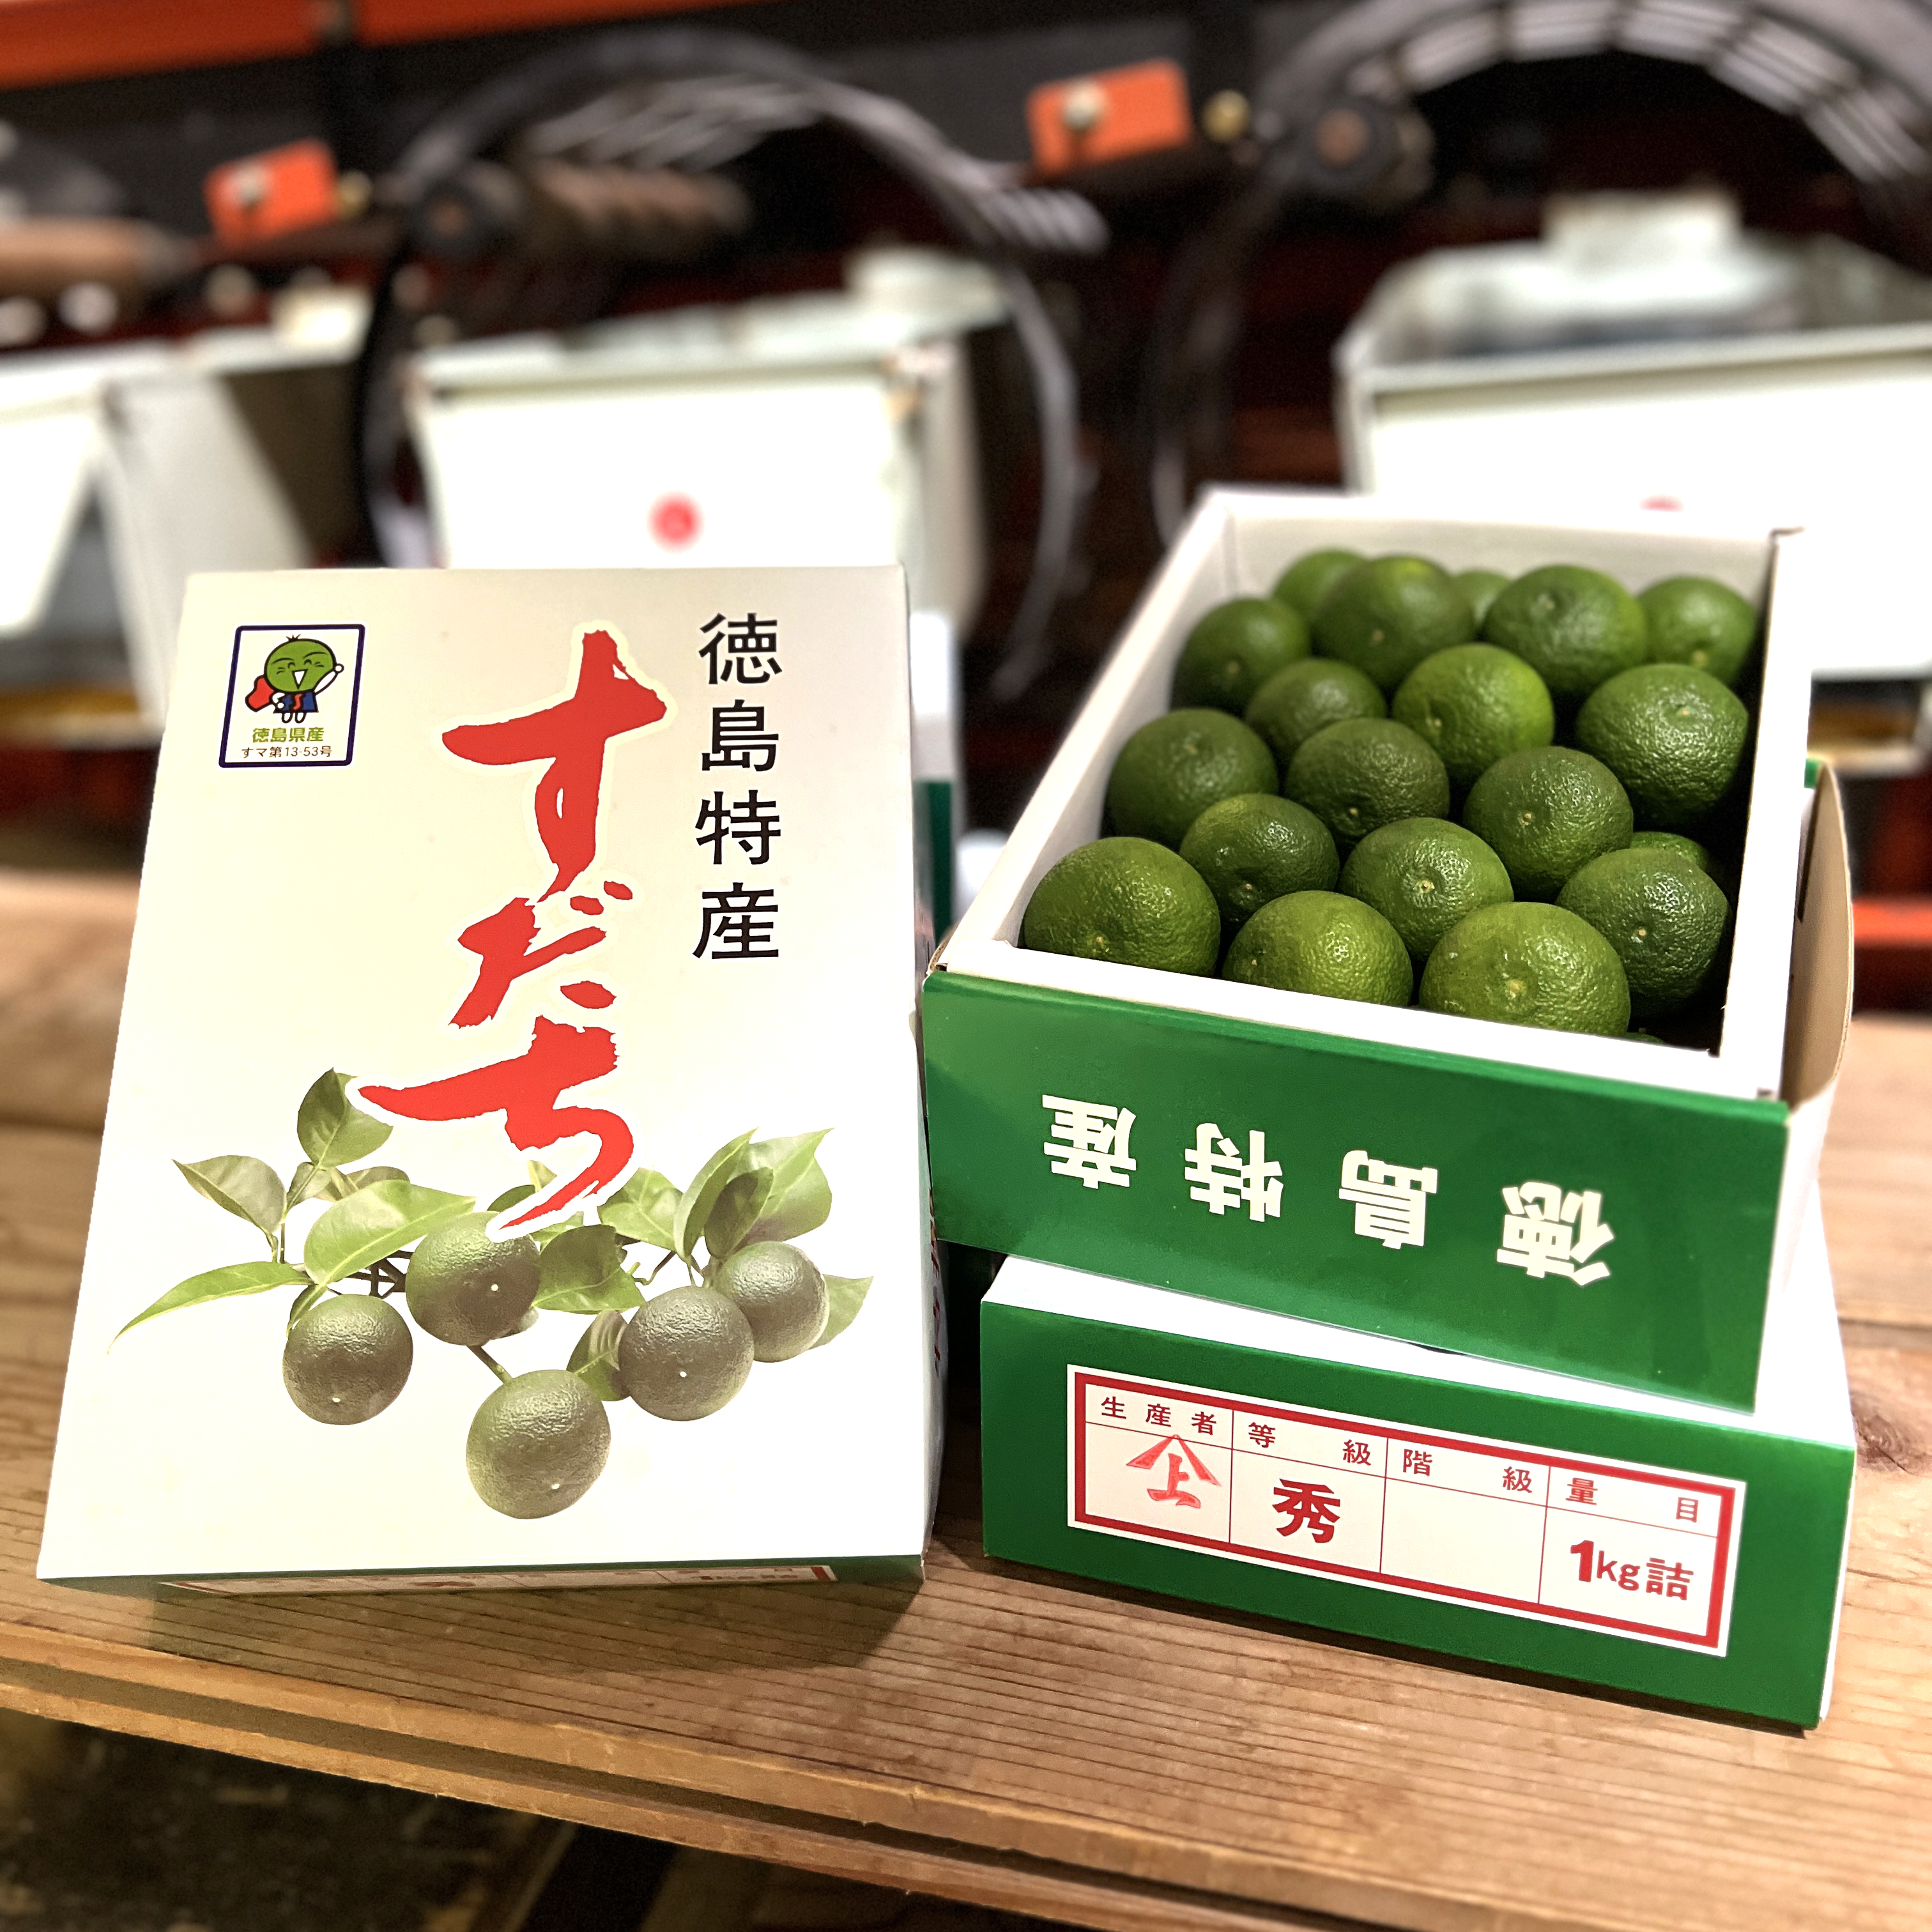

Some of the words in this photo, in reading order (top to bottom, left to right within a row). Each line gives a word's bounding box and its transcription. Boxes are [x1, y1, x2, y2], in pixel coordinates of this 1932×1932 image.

[252, 726, 325, 743] 徳島県産
[692, 612, 783, 960] 徳島特産
[357, 629, 668, 1230] すだち
[1041, 1093, 1614, 1287] 徳島特産
[1100, 1395, 1217, 1436] 生産者
[1272, 1478, 1341, 1544] 秀
